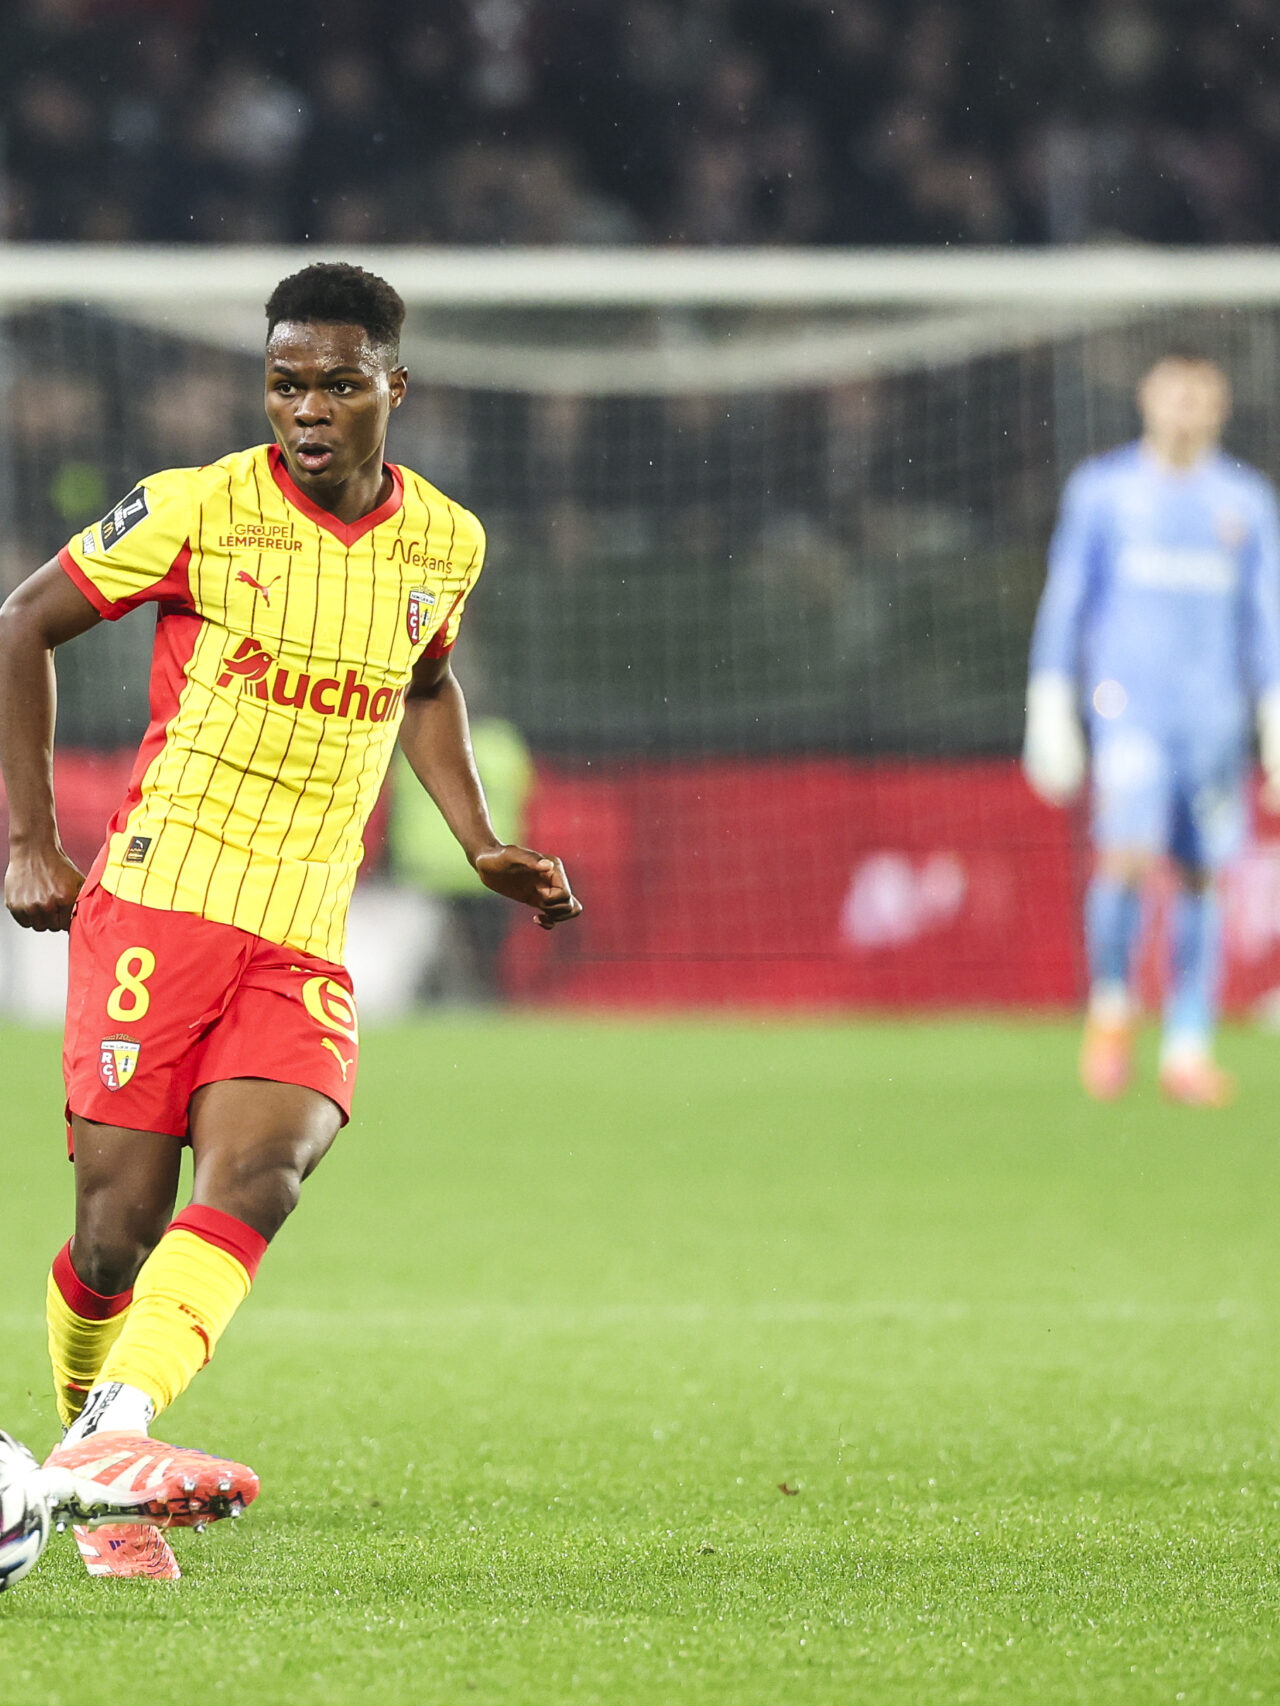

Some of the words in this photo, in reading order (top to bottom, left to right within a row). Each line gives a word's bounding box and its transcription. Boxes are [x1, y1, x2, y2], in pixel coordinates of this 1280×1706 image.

[218, 535, 303, 552] LEMPEREUR
[234, 523, 289, 538] GROUPE
[386, 538, 453, 574] Nexans
[106, 946, 156, 1022] 8
[101, 1051, 117, 1087] RCL
